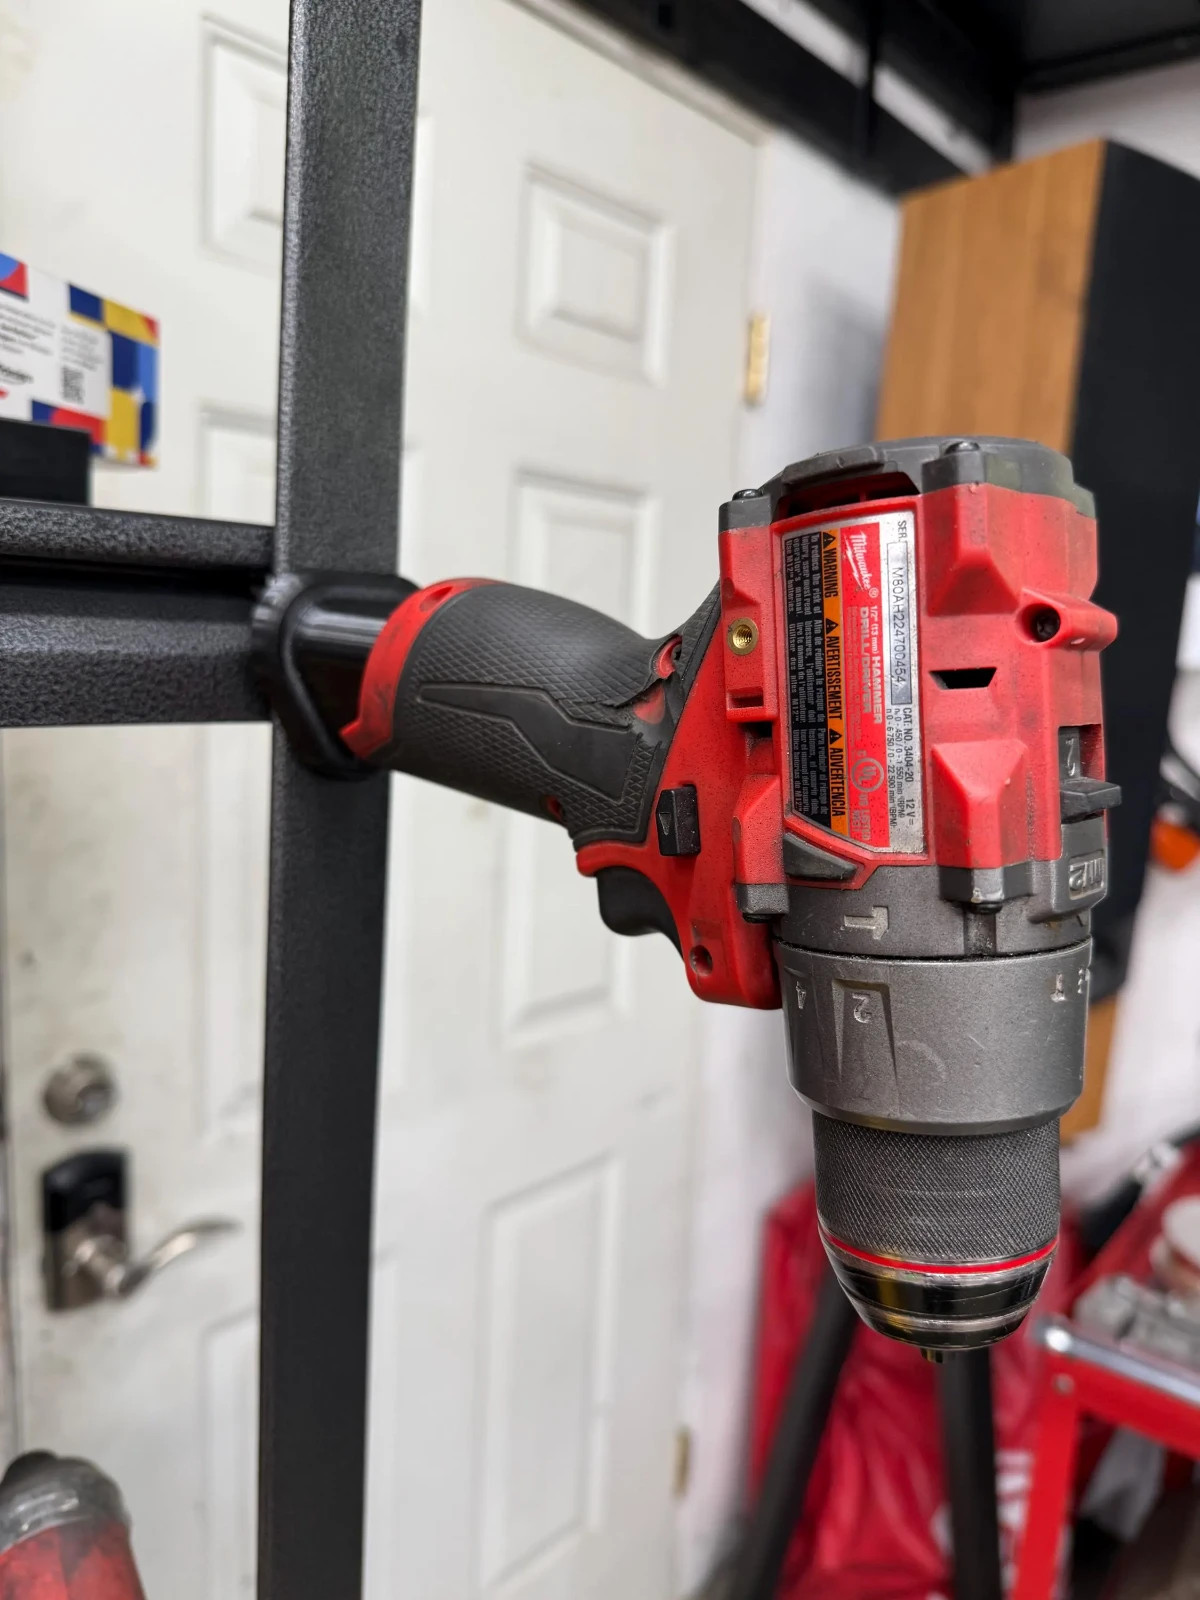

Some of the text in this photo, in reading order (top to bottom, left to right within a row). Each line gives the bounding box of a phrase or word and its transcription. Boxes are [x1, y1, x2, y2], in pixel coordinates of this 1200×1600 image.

[898, 521, 907, 542] SER.
[823, 548, 838, 598] WARNING
[849, 530, 872, 590] Milwaukee
[804, 598, 812, 616] read
[812, 588, 822, 603] risk
[826, 636, 842, 720] AVERTISSEMENT
[860, 606, 872, 714] DRILL/DRIVER
[872, 656, 882, 724] HAMMER
[904, 728, 912, 743] NO.
[830, 748, 846, 816] ADVERTENCIA
[904, 746, 914, 782] 3404-20
[906, 798, 914, 810] 12
[852, 992, 872, 1024] 2
